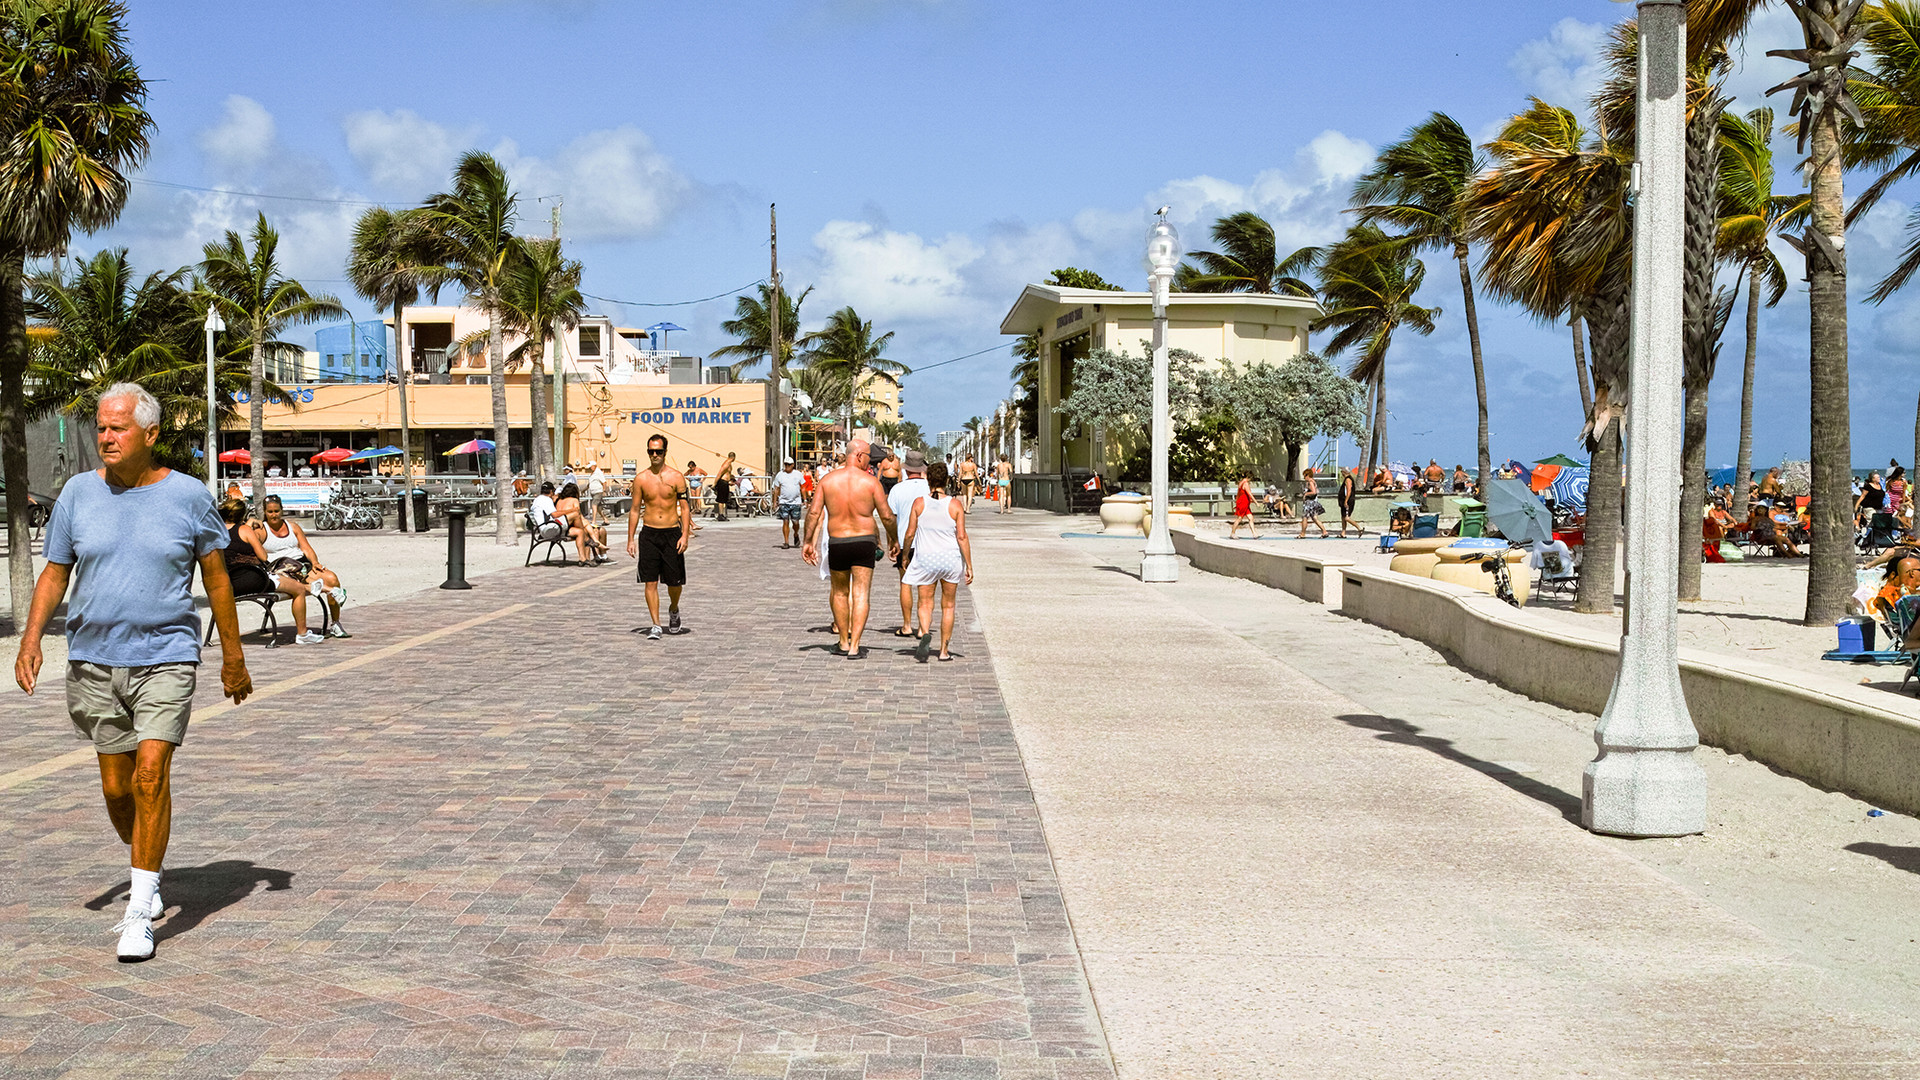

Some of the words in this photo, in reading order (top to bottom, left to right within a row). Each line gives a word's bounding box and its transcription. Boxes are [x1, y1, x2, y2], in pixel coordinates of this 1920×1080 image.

[662, 397, 721, 409] DAHAN
[631, 412, 675, 424] FOOD
[681, 412, 751, 424] MARKET
